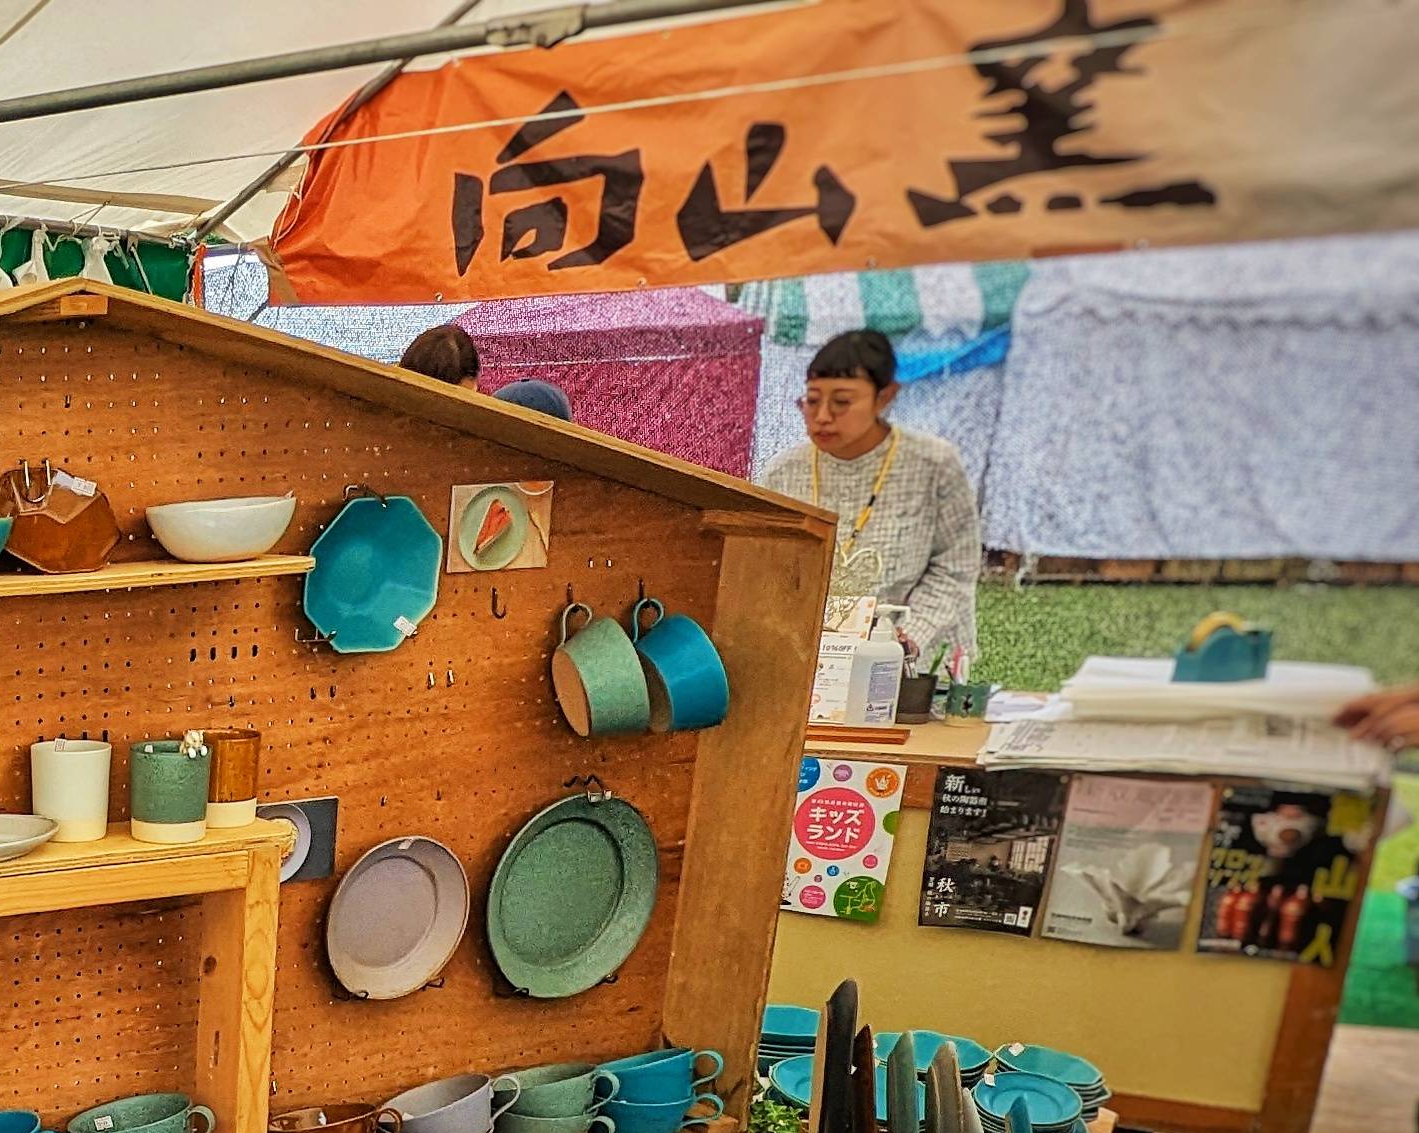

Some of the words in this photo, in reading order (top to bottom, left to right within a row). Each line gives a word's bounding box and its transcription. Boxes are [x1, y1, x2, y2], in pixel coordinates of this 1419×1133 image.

[809, 807, 865, 826] キッズ
[807, 825, 860, 843] ランド
